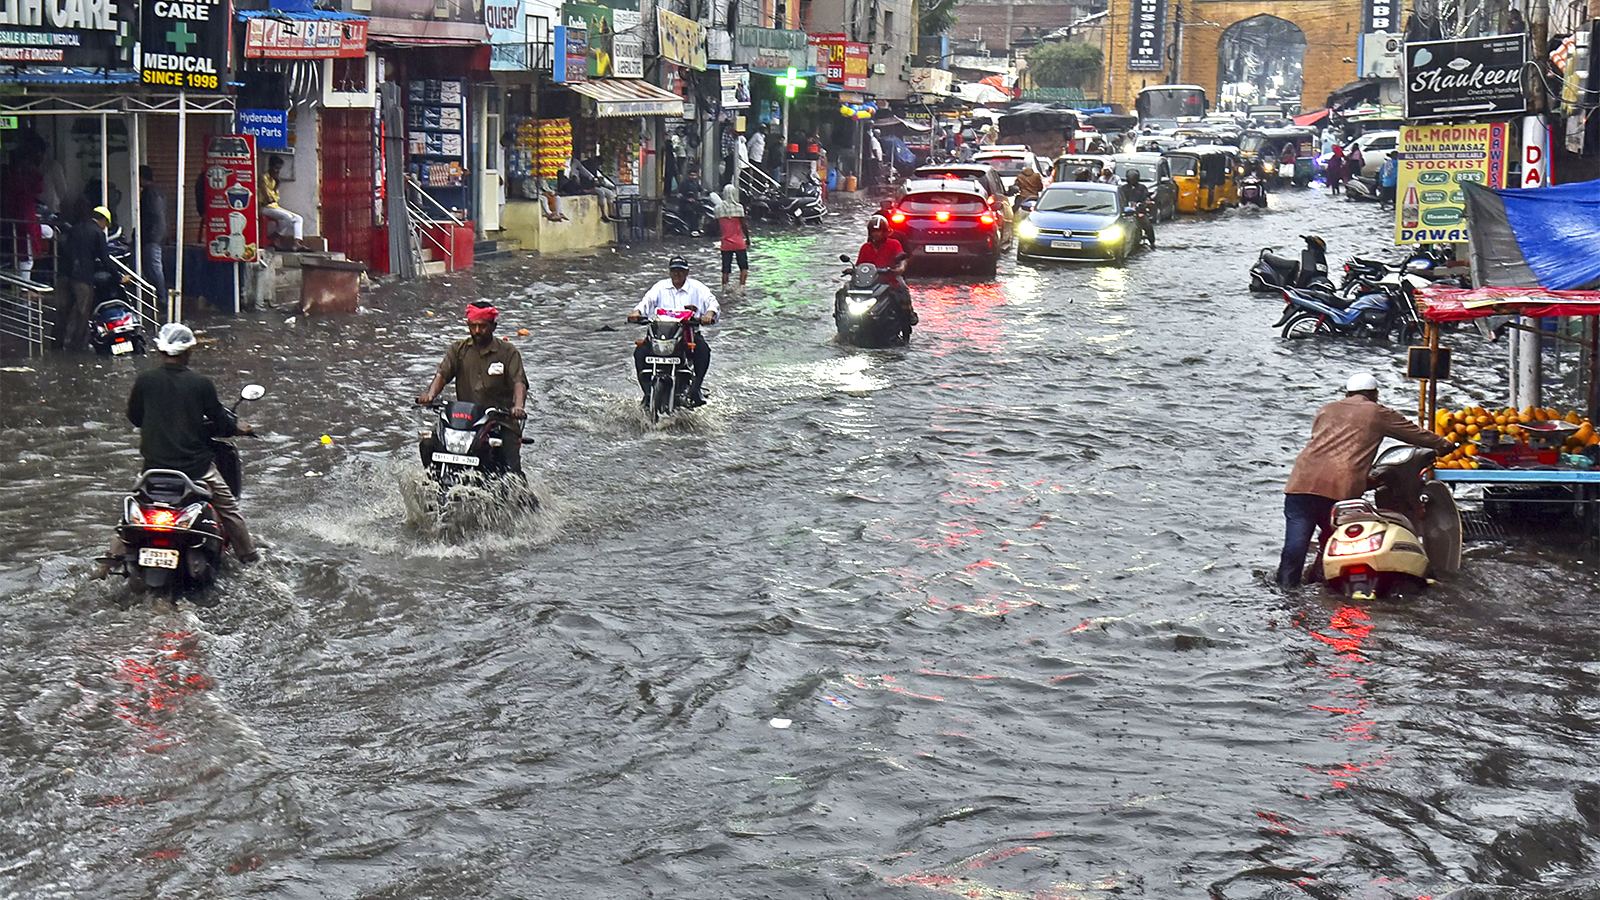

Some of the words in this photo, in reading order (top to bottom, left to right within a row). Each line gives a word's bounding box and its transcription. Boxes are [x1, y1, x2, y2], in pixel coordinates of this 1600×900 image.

[45, 0, 118, 31] CARE
[154, 2, 209, 21] CARE
[53, 33, 80, 46] MEDICAL
[32, 48, 64, 61] DRUGGIST
[144, 53, 217, 73] MEDICAL
[143, 70, 184, 86] SINCE
[186, 74, 219, 89] 1998
[1411, 63, 1520, 92] Shaukeen
[240, 112, 283, 124] Hyderabad
[242, 126, 260, 136] Auto
[260, 127, 283, 138] Parts
[1405, 128, 1488, 143] AL-MADINA
[1439, 143, 1486, 151] DAWASAZ
[1406, 160, 1484, 170] STOCKIST
